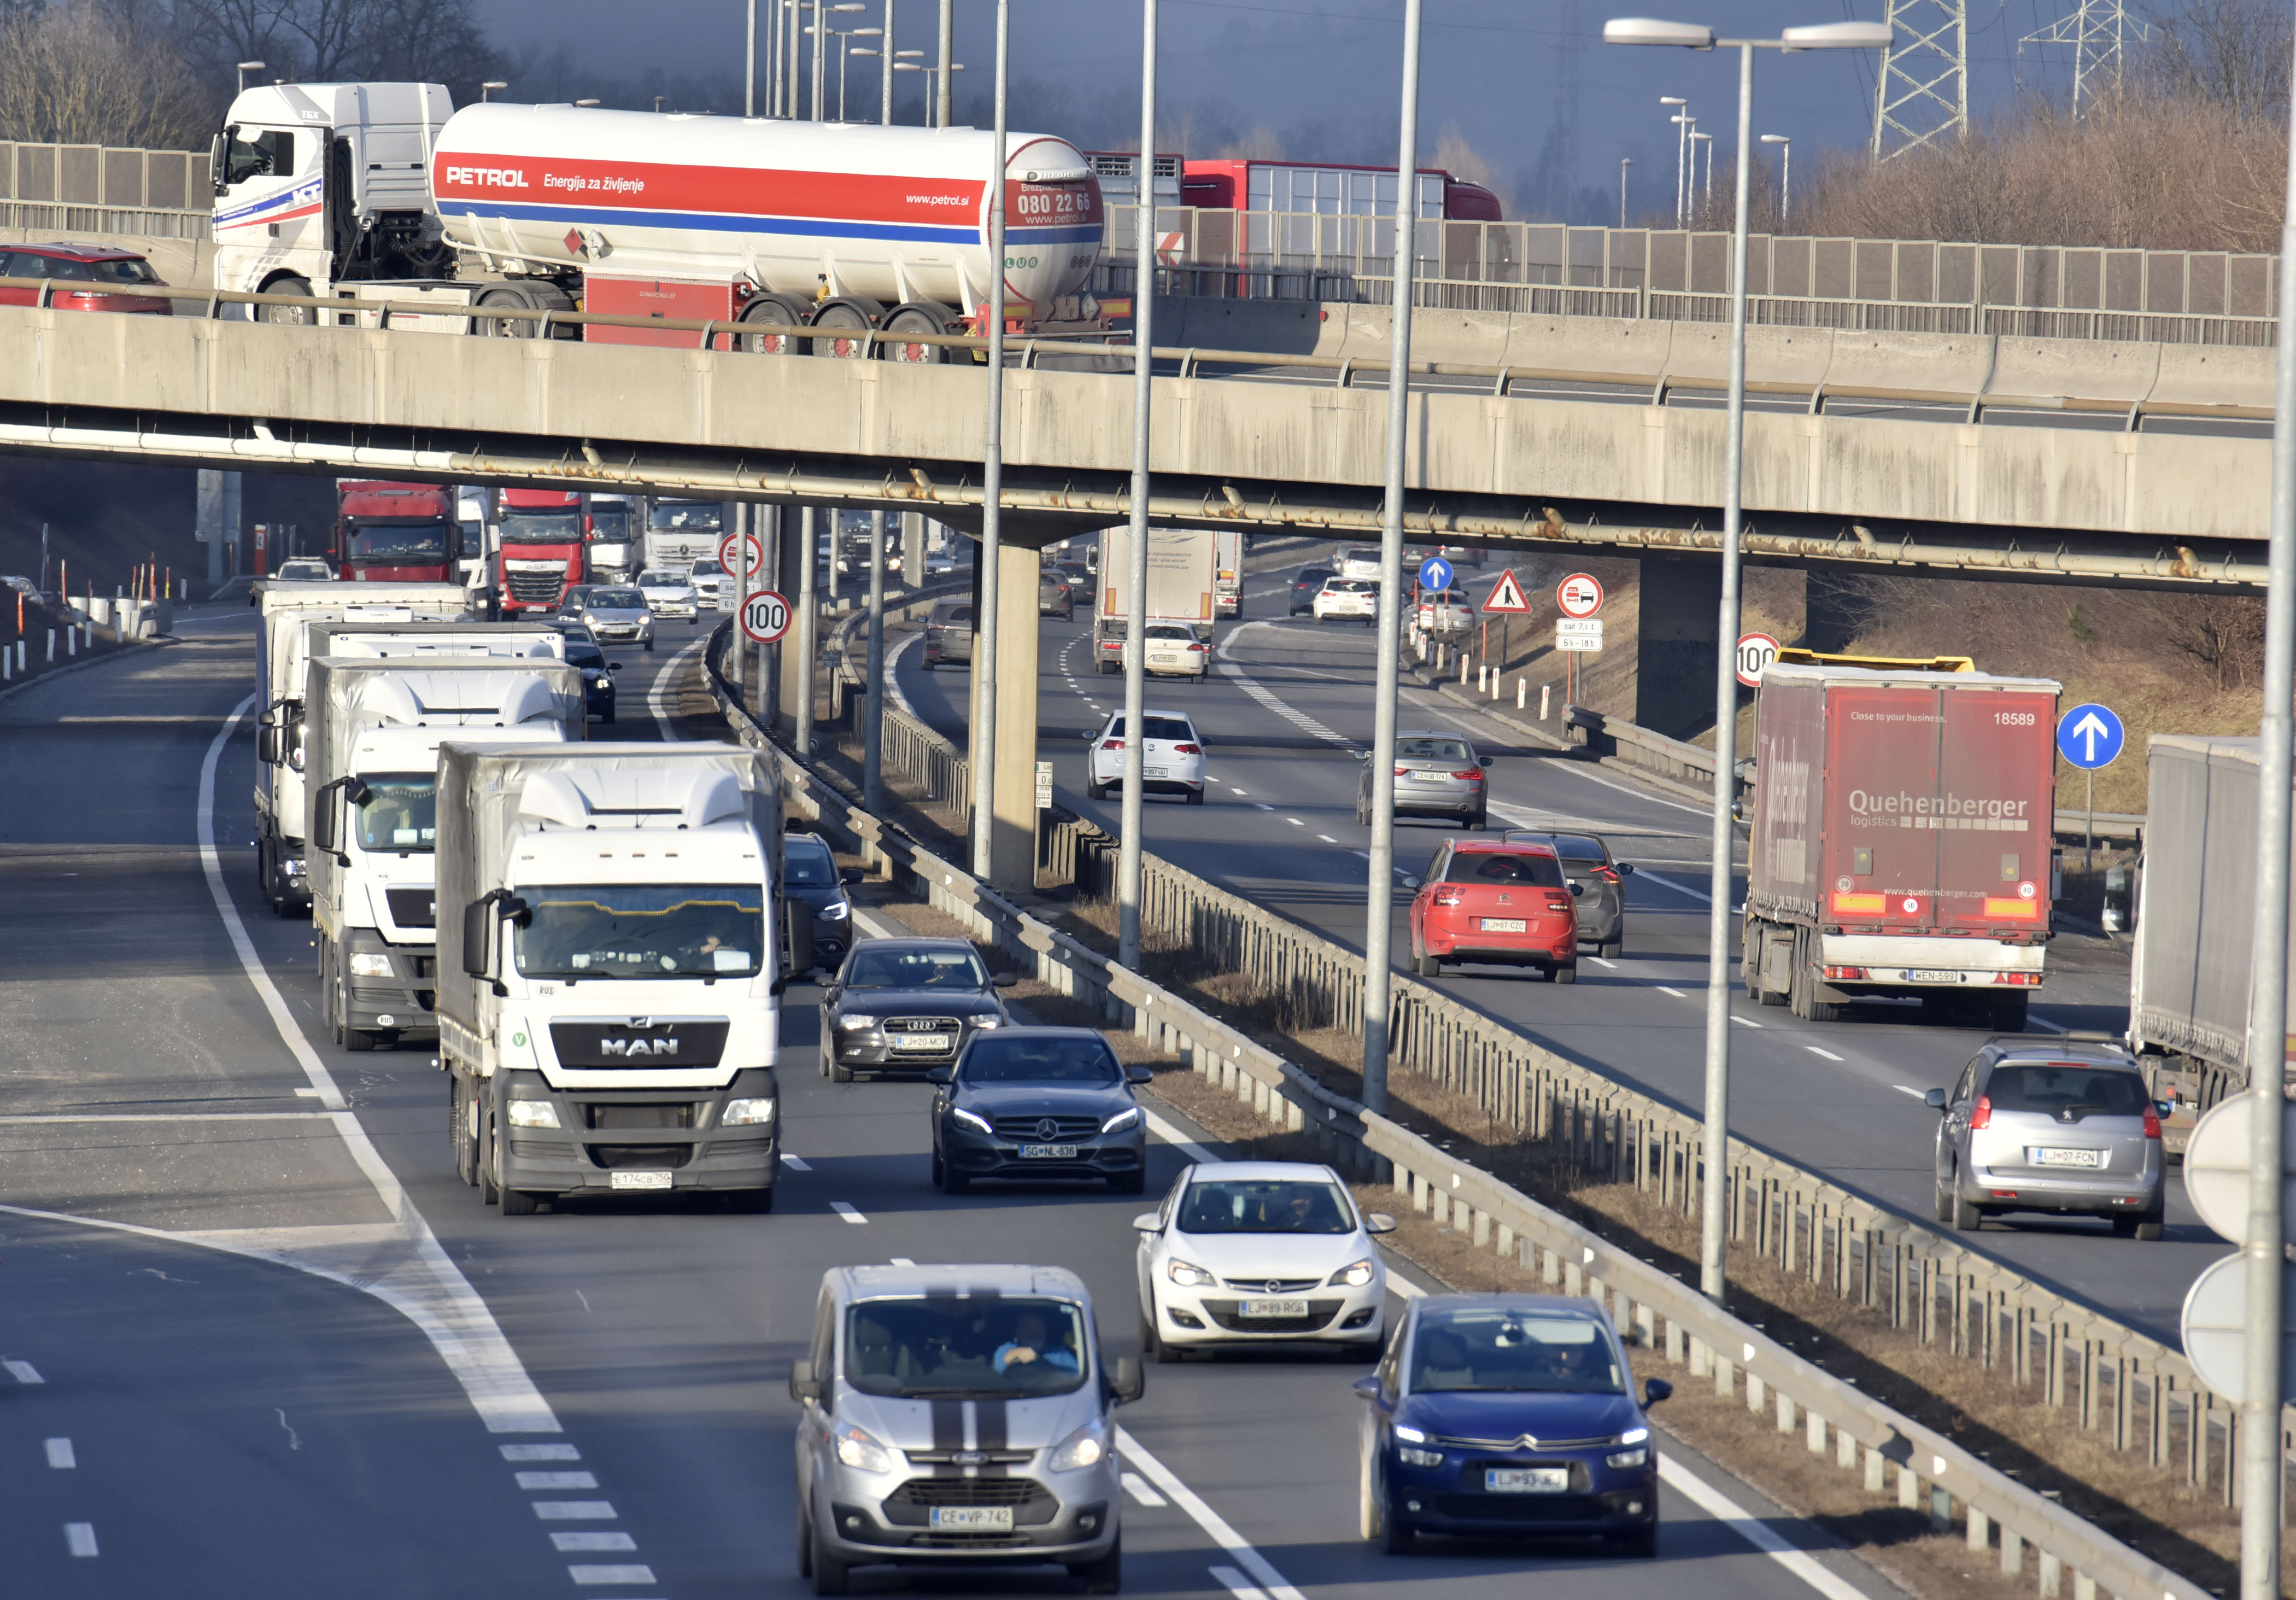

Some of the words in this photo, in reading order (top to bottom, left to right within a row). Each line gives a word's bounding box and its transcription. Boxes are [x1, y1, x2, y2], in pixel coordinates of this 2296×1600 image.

[302, 110, 319, 119] TGX
[446, 166, 529, 188] PETROL
[543, 174, 585, 191] Energija
[588, 179, 600, 190] za
[602, 177, 645, 194] življenje
[292, 184, 320, 206] KT
[906, 195, 970, 206] www.petrol.si
[1017, 194, 1050, 214] 080
[1056, 194, 1073, 212] 22
[1076, 192, 1090, 211] 66
[1026, 213, 1087, 225] www.petrol.si
[748, 604, 784, 629] 100
[1738, 646, 1776, 673] 100
[1850, 711, 1875, 720] Close
[1876, 713, 1884, 721] to
[1886, 714, 1905, 722] your
[1907, 713, 1947, 722] business.
[1994, 713, 2035, 726] 18589
[1849, 790, 2028, 820] Quehenberger
[1850, 815, 1897, 828] logistics
[1884, 887, 1987, 898] www.quehenberger.com
[1916, 971, 1954, 980] WEN-599
[539, 986, 554, 995] RUS
[601, 1039, 678, 1055] MAN
[918, 1037, 946, 1046] 20-MCV
[1026, 1146, 1038, 1155] SG
[2045, 1151, 2055, 1160] LJ
[2063, 1152, 2095, 1163] 07-FCN
[1248, 1302, 1261, 1313] LJ
[941, 1510, 957, 1523] CE
[967, 1510, 1009, 1523] VP-742
